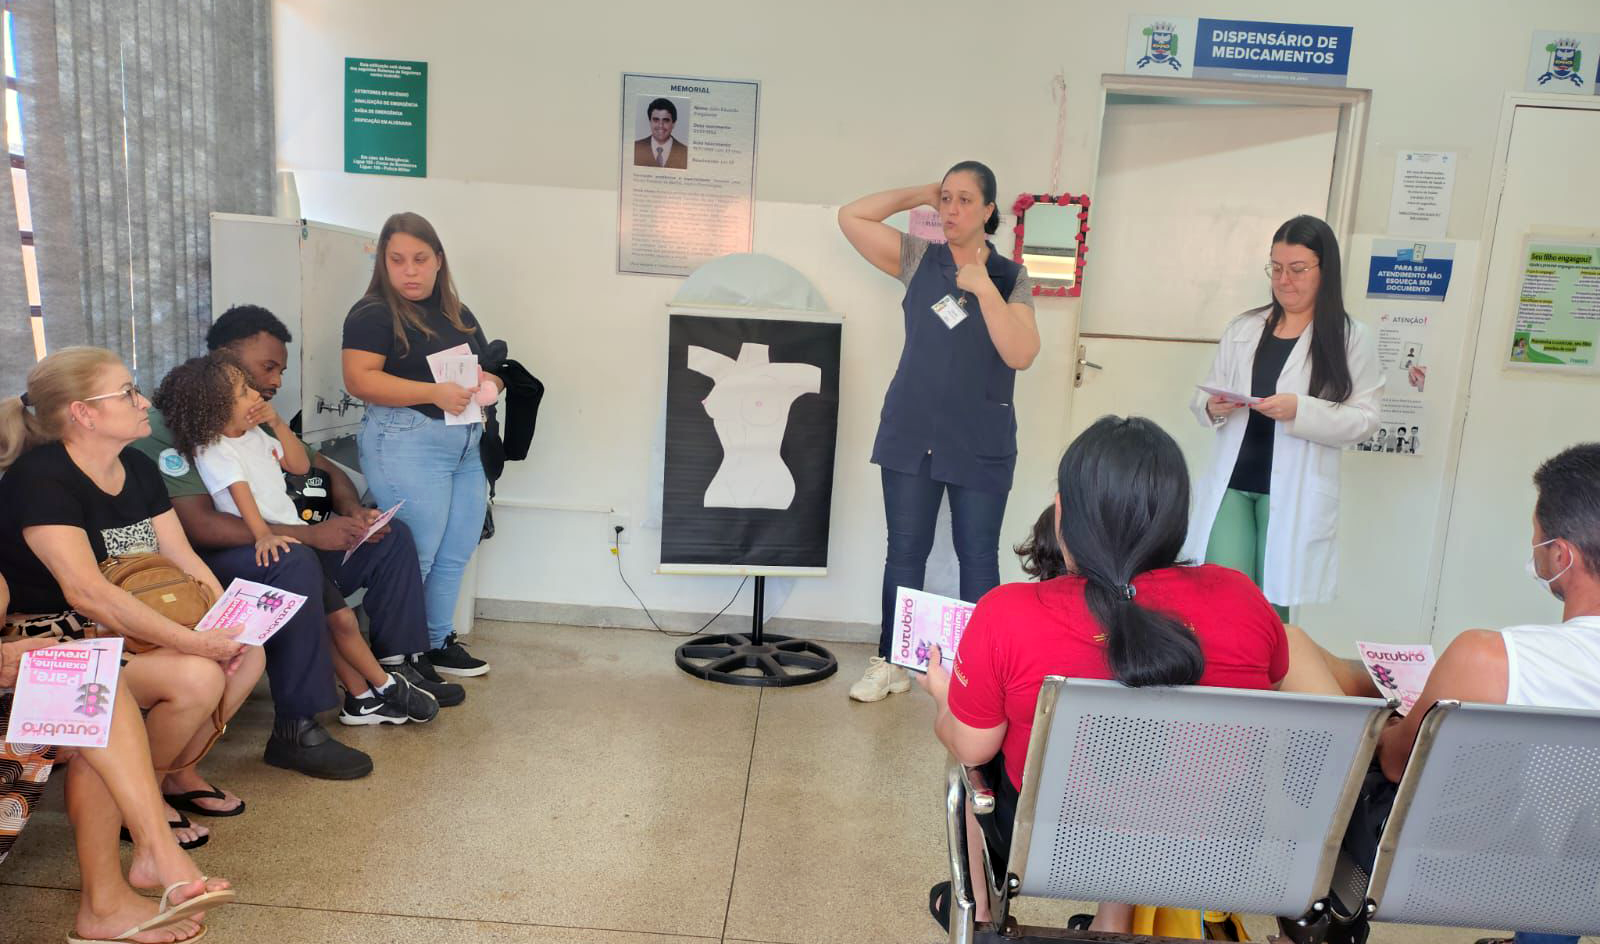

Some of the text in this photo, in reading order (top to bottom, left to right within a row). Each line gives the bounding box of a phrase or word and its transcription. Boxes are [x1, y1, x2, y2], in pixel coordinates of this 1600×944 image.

[1212, 30, 1338, 49] DISPENSÁRIO DE
[1212, 46, 1334, 64] MEDICAMENTOS
[671, 85, 710, 93] MEMORIAL
[1557, 255, 1592, 263] engasgou?
[1378, 270, 1442, 279] ATENDIMENTO NÃO
[1386, 278, 1417, 286] ESQUEÇA
[258, 600, 295, 639] outubro
[901, 598, 914, 658] outubro
[33, 650, 89, 659] previna!
[1366, 650, 1424, 661] outubro
[33, 660, 87, 670] examine,
[33, 670, 80, 686] Pare,
[22, 722, 100, 736] outubro
